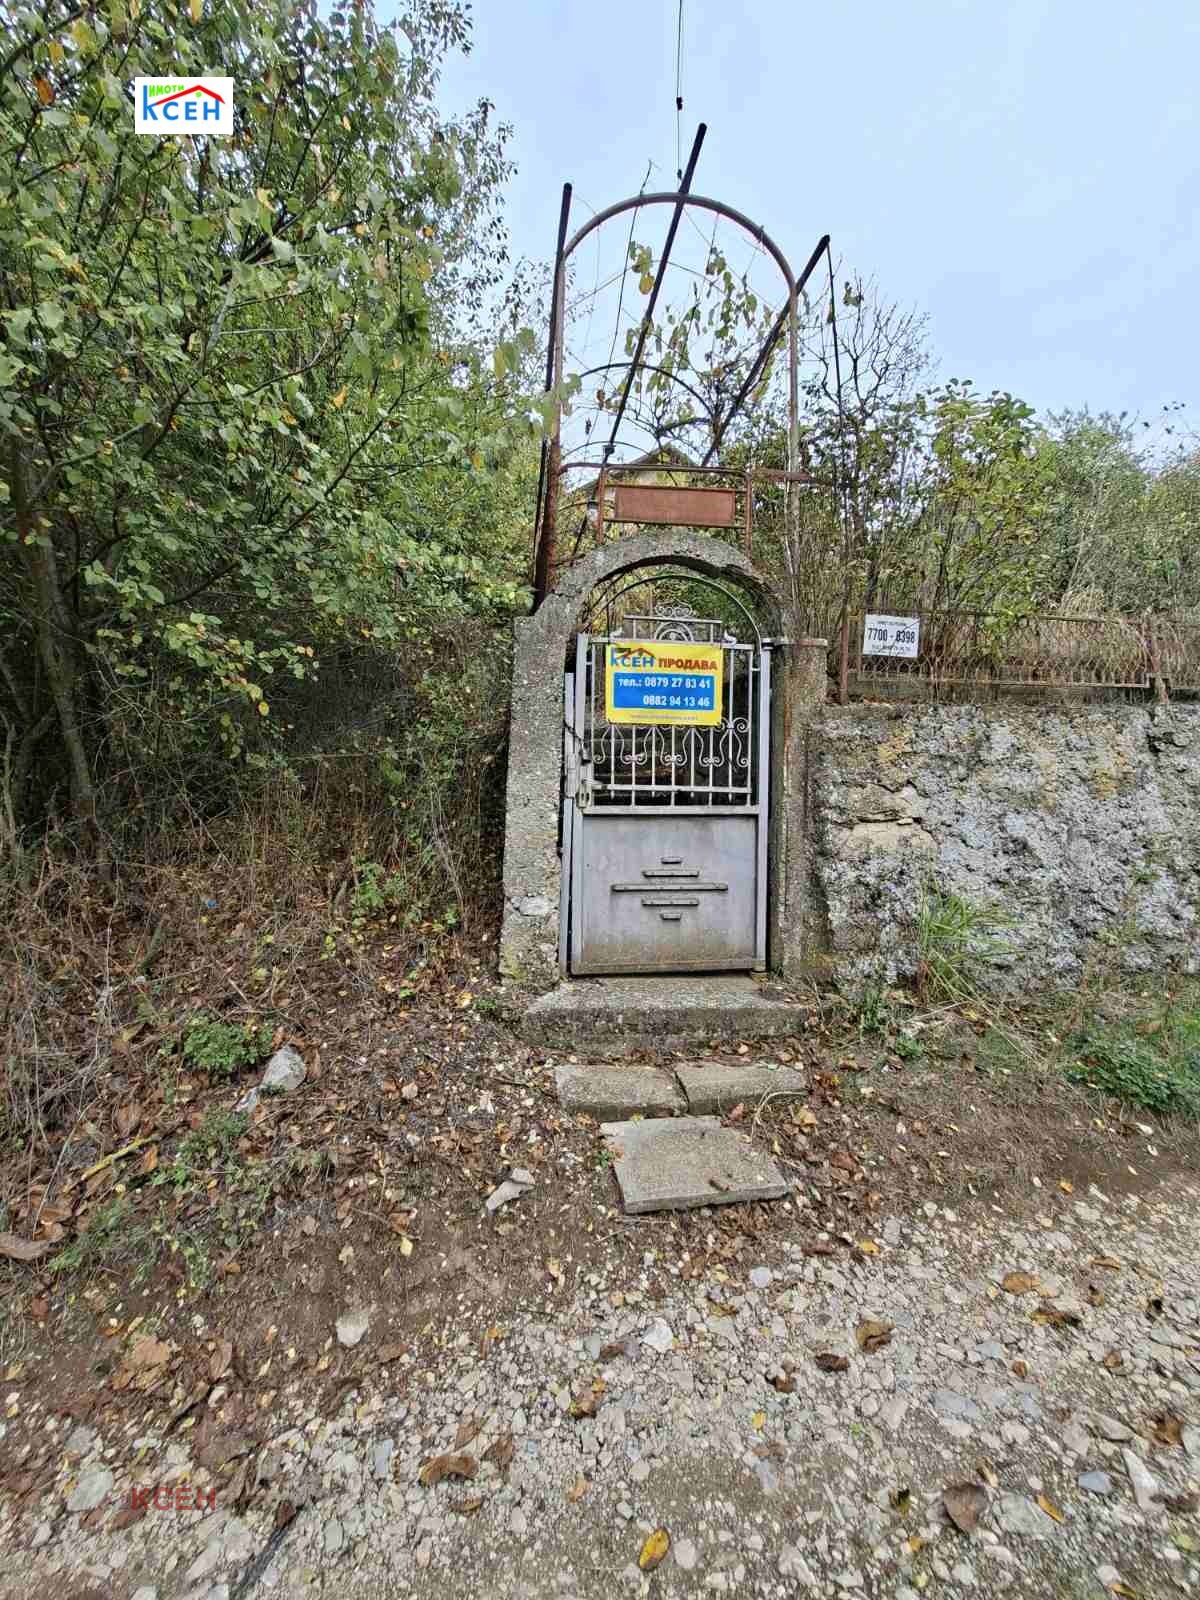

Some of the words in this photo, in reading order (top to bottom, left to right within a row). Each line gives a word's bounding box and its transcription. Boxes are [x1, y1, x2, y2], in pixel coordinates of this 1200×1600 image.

[867, 628, 888, 641] 7700
[658, 658, 718, 671] ПРОДАВА
[645, 677, 669, 688] 0879
[671, 678, 682, 688] 27
[699, 679, 711, 689] 41
[669, 696, 681, 706] 94
[684, 696, 695, 707] 13
